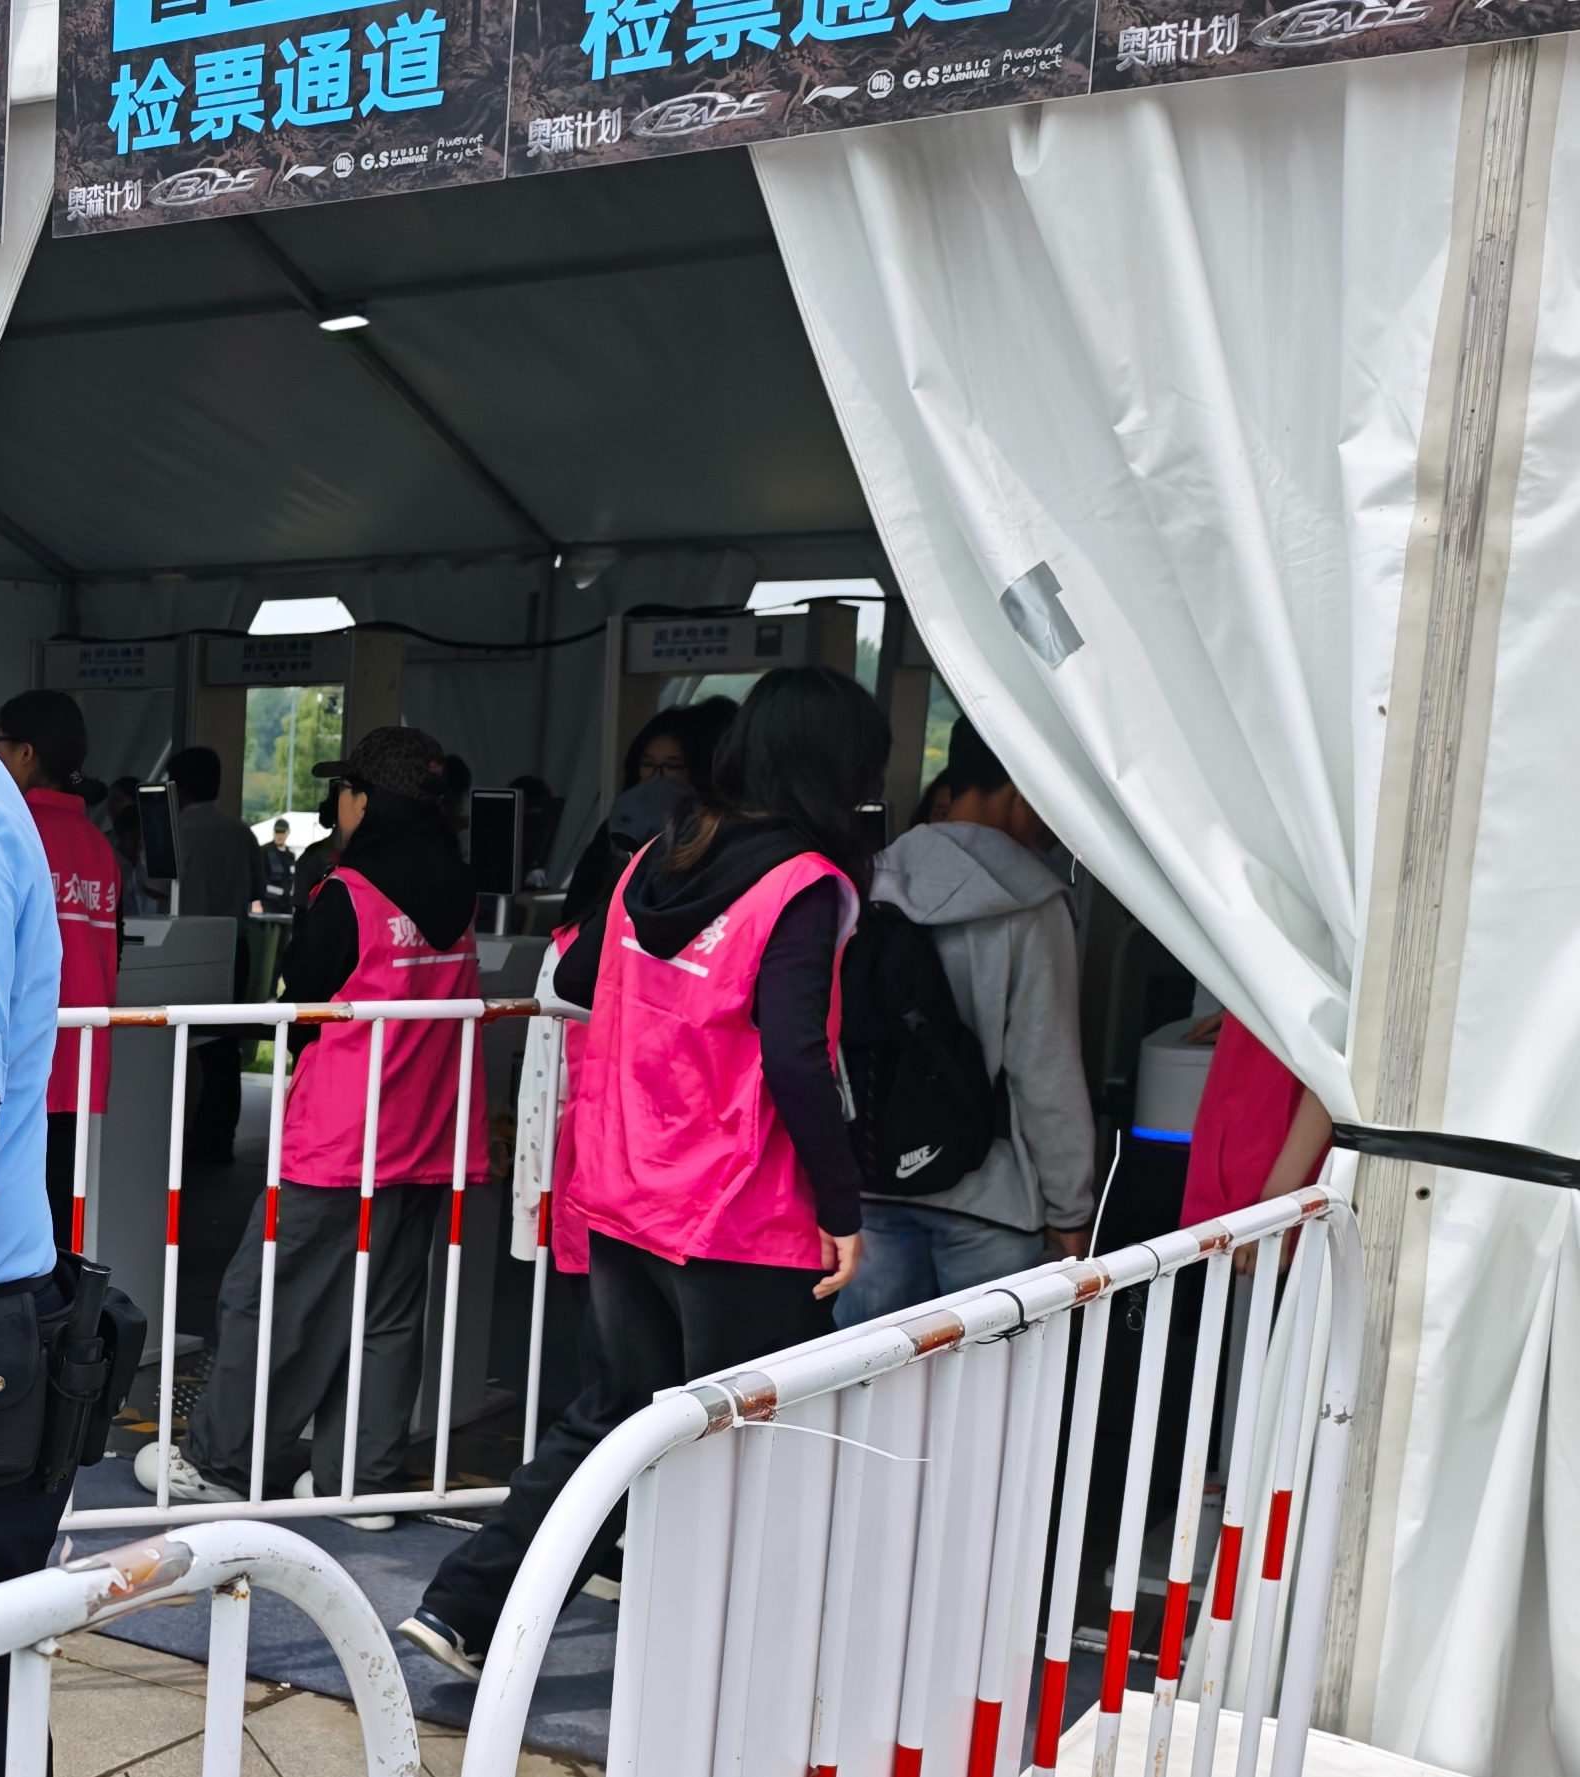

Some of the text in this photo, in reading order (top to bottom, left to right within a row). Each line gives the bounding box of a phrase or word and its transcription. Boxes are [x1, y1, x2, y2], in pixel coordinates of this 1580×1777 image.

[1115, 13, 1241, 72] 奥森计划
[941, 58, 991, 75] MUSIC
[941, 68, 991, 84] CARNIVAL
[1001, 54, 1062, 78] Project
[107, 8, 446, 155] 检票通道
[527, 108, 622, 158] 奥森计划
[390, 145, 429, 159] MUSIC
[390, 154, 428, 167] CARNIVAL
[435, 144, 484, 163] Project
[67, 179, 142, 221] 奥森计划
[900, 1144, 931, 1168] NIKE
